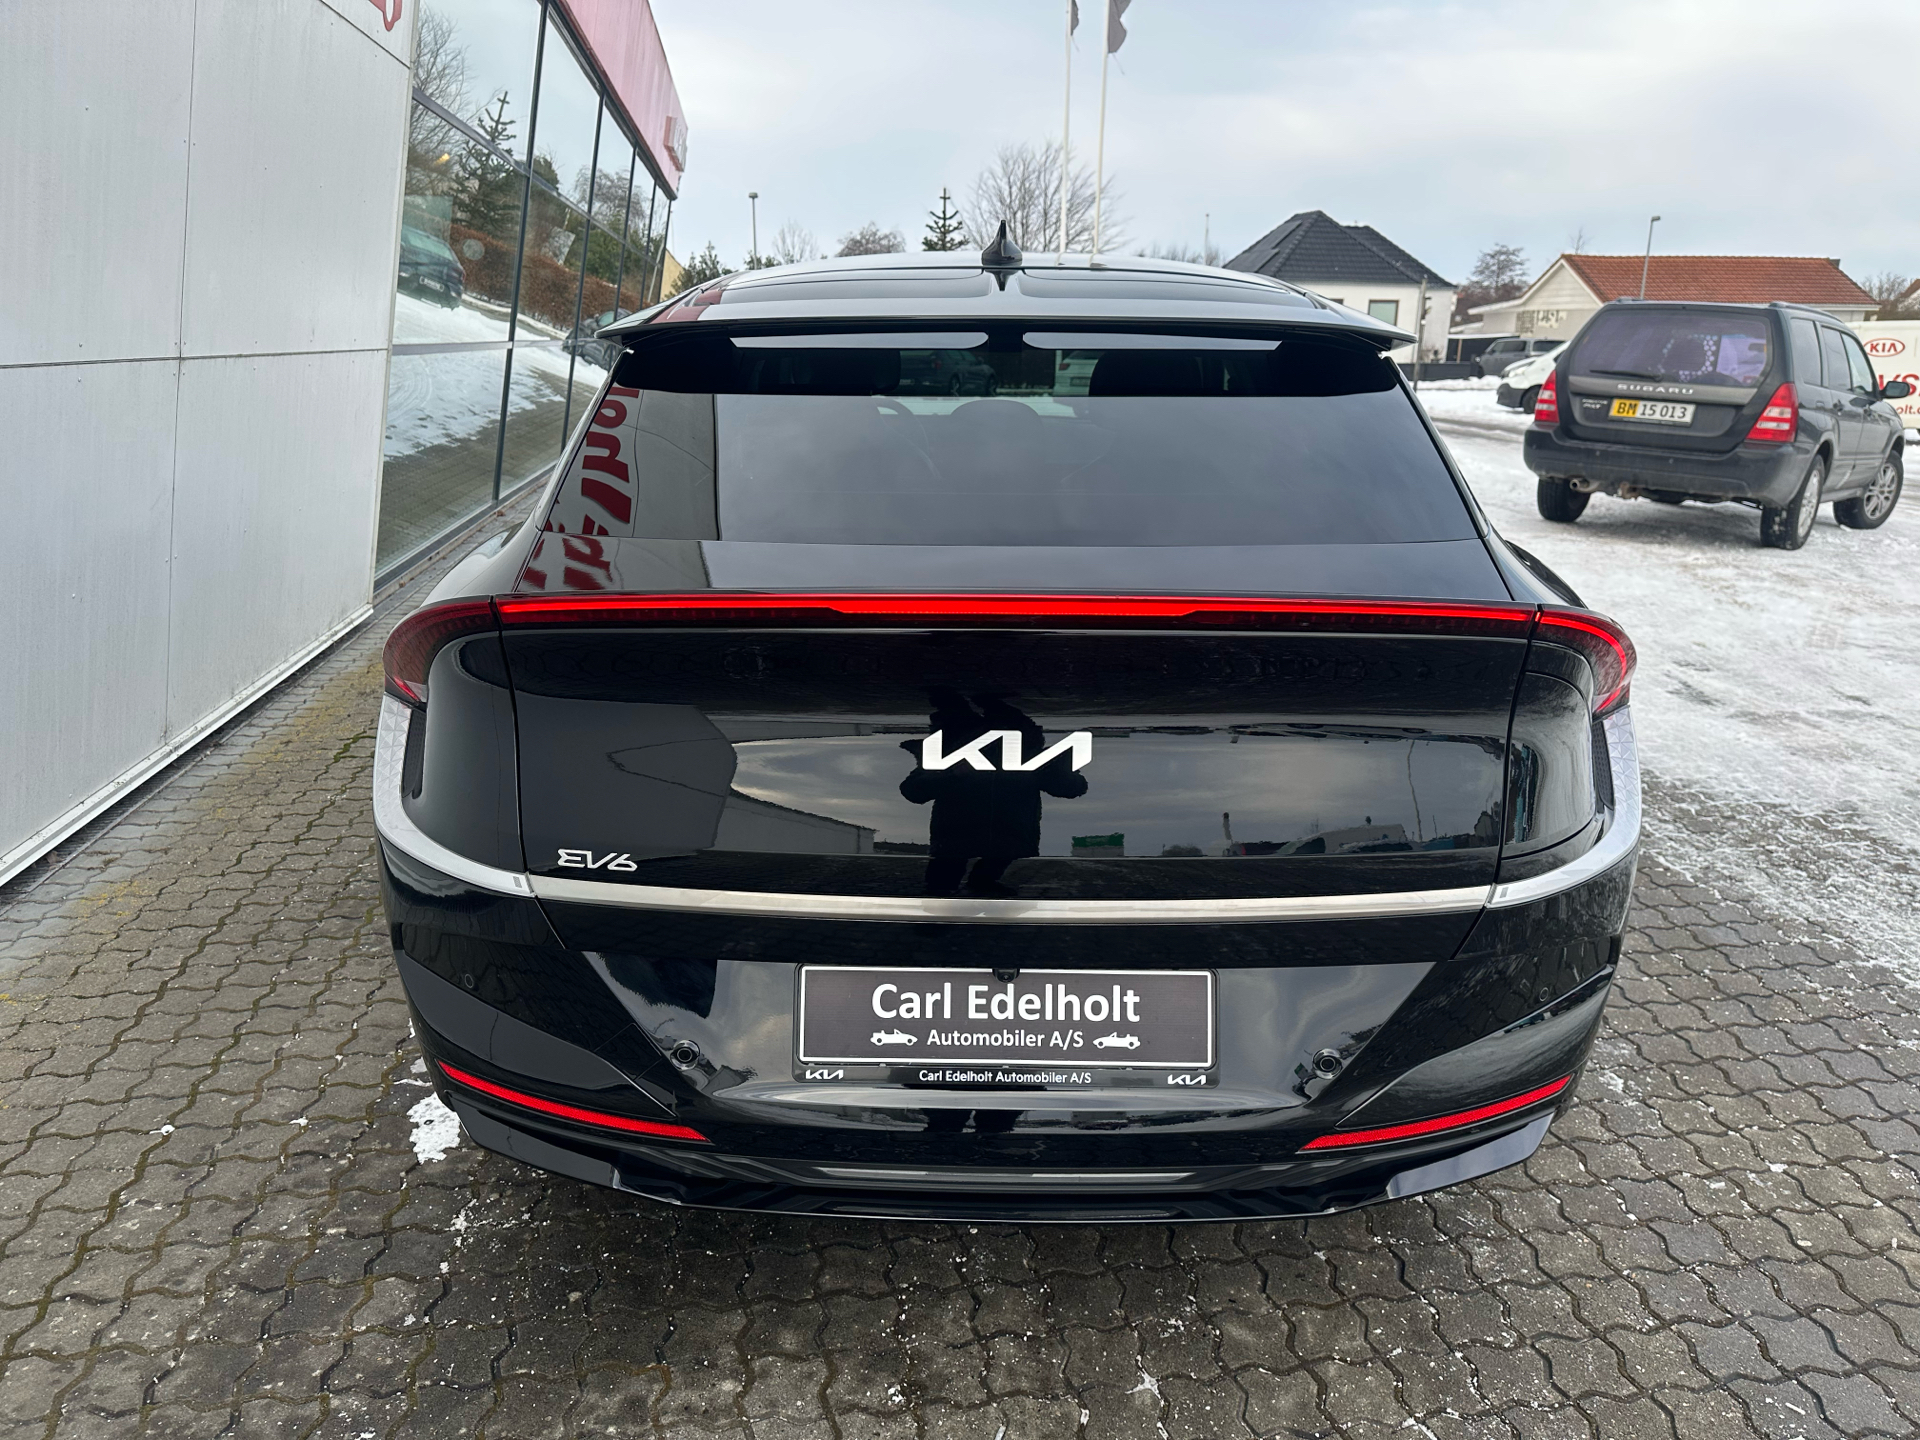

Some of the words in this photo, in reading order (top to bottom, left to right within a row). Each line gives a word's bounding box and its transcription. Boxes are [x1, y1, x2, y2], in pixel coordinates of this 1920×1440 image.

[1869, 342, 1897, 353] KIA
[1617, 383, 1694, 395] SUBARU
[1616, 402, 1639, 416] BM
[1640, 403, 1657, 417] 15
[1659, 404, 1688, 419] 013
[922, 729, 1093, 771] KIA
[557, 848, 638, 872] EV6
[871, 982, 952, 1019] Carl
[967, 983, 1141, 1023] Edelholt
[926, 1028, 1046, 1048] Automobiler
[1049, 1029, 1084, 1051] A/S
[805, 1069, 844, 1080] KIA
[918, 1069, 943, 1081] Carl
[944, 1069, 993, 1083] Edelholt
[995, 1070, 1068, 1084] Automobiler
[1069, 1071, 1092, 1085] A/S
[1167, 1073, 1207, 1085] KIA
